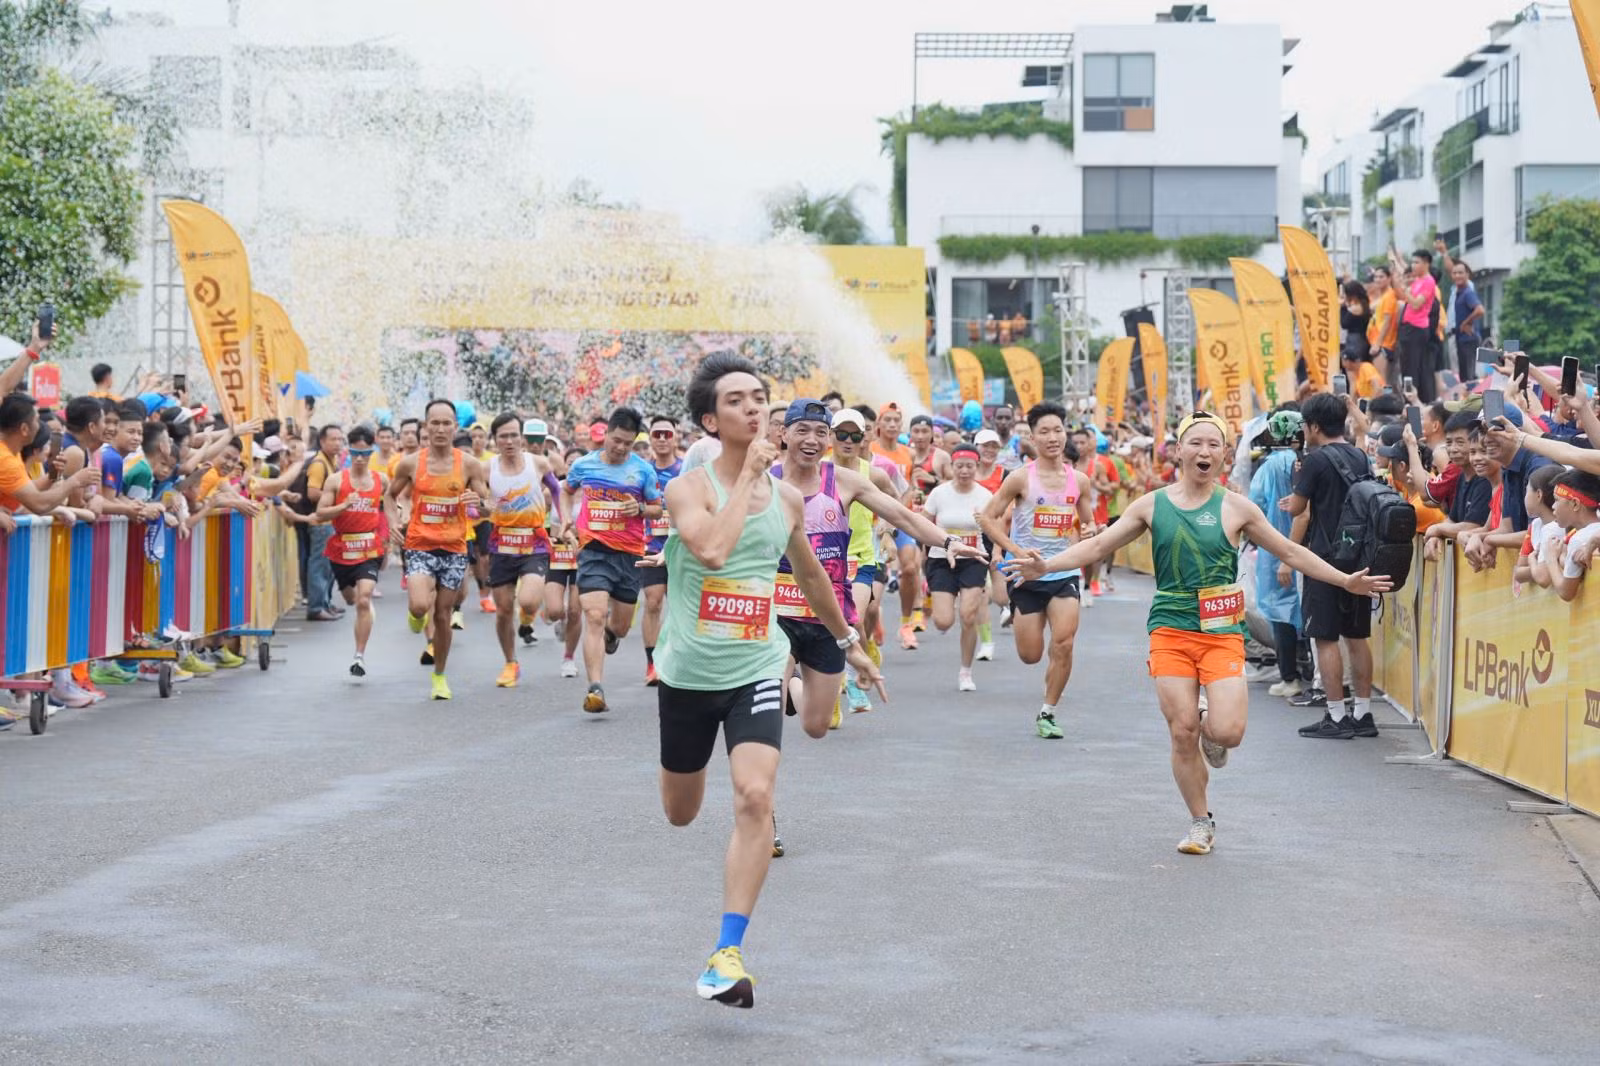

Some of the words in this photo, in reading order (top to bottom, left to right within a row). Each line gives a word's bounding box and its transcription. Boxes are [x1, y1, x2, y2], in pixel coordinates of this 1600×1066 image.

[1316, 289, 1330, 344] GIAN
[210, 307, 246, 423] PBank
[1220, 361, 1243, 435] PBank
[590, 509, 613, 519] 99909
[1038, 514, 1062, 525] 95195
[777, 585, 805, 599] 9460
[707, 595, 754, 616] 99098
[1204, 596, 1237, 612] 96395
[1463, 636, 1530, 709] LPBank
